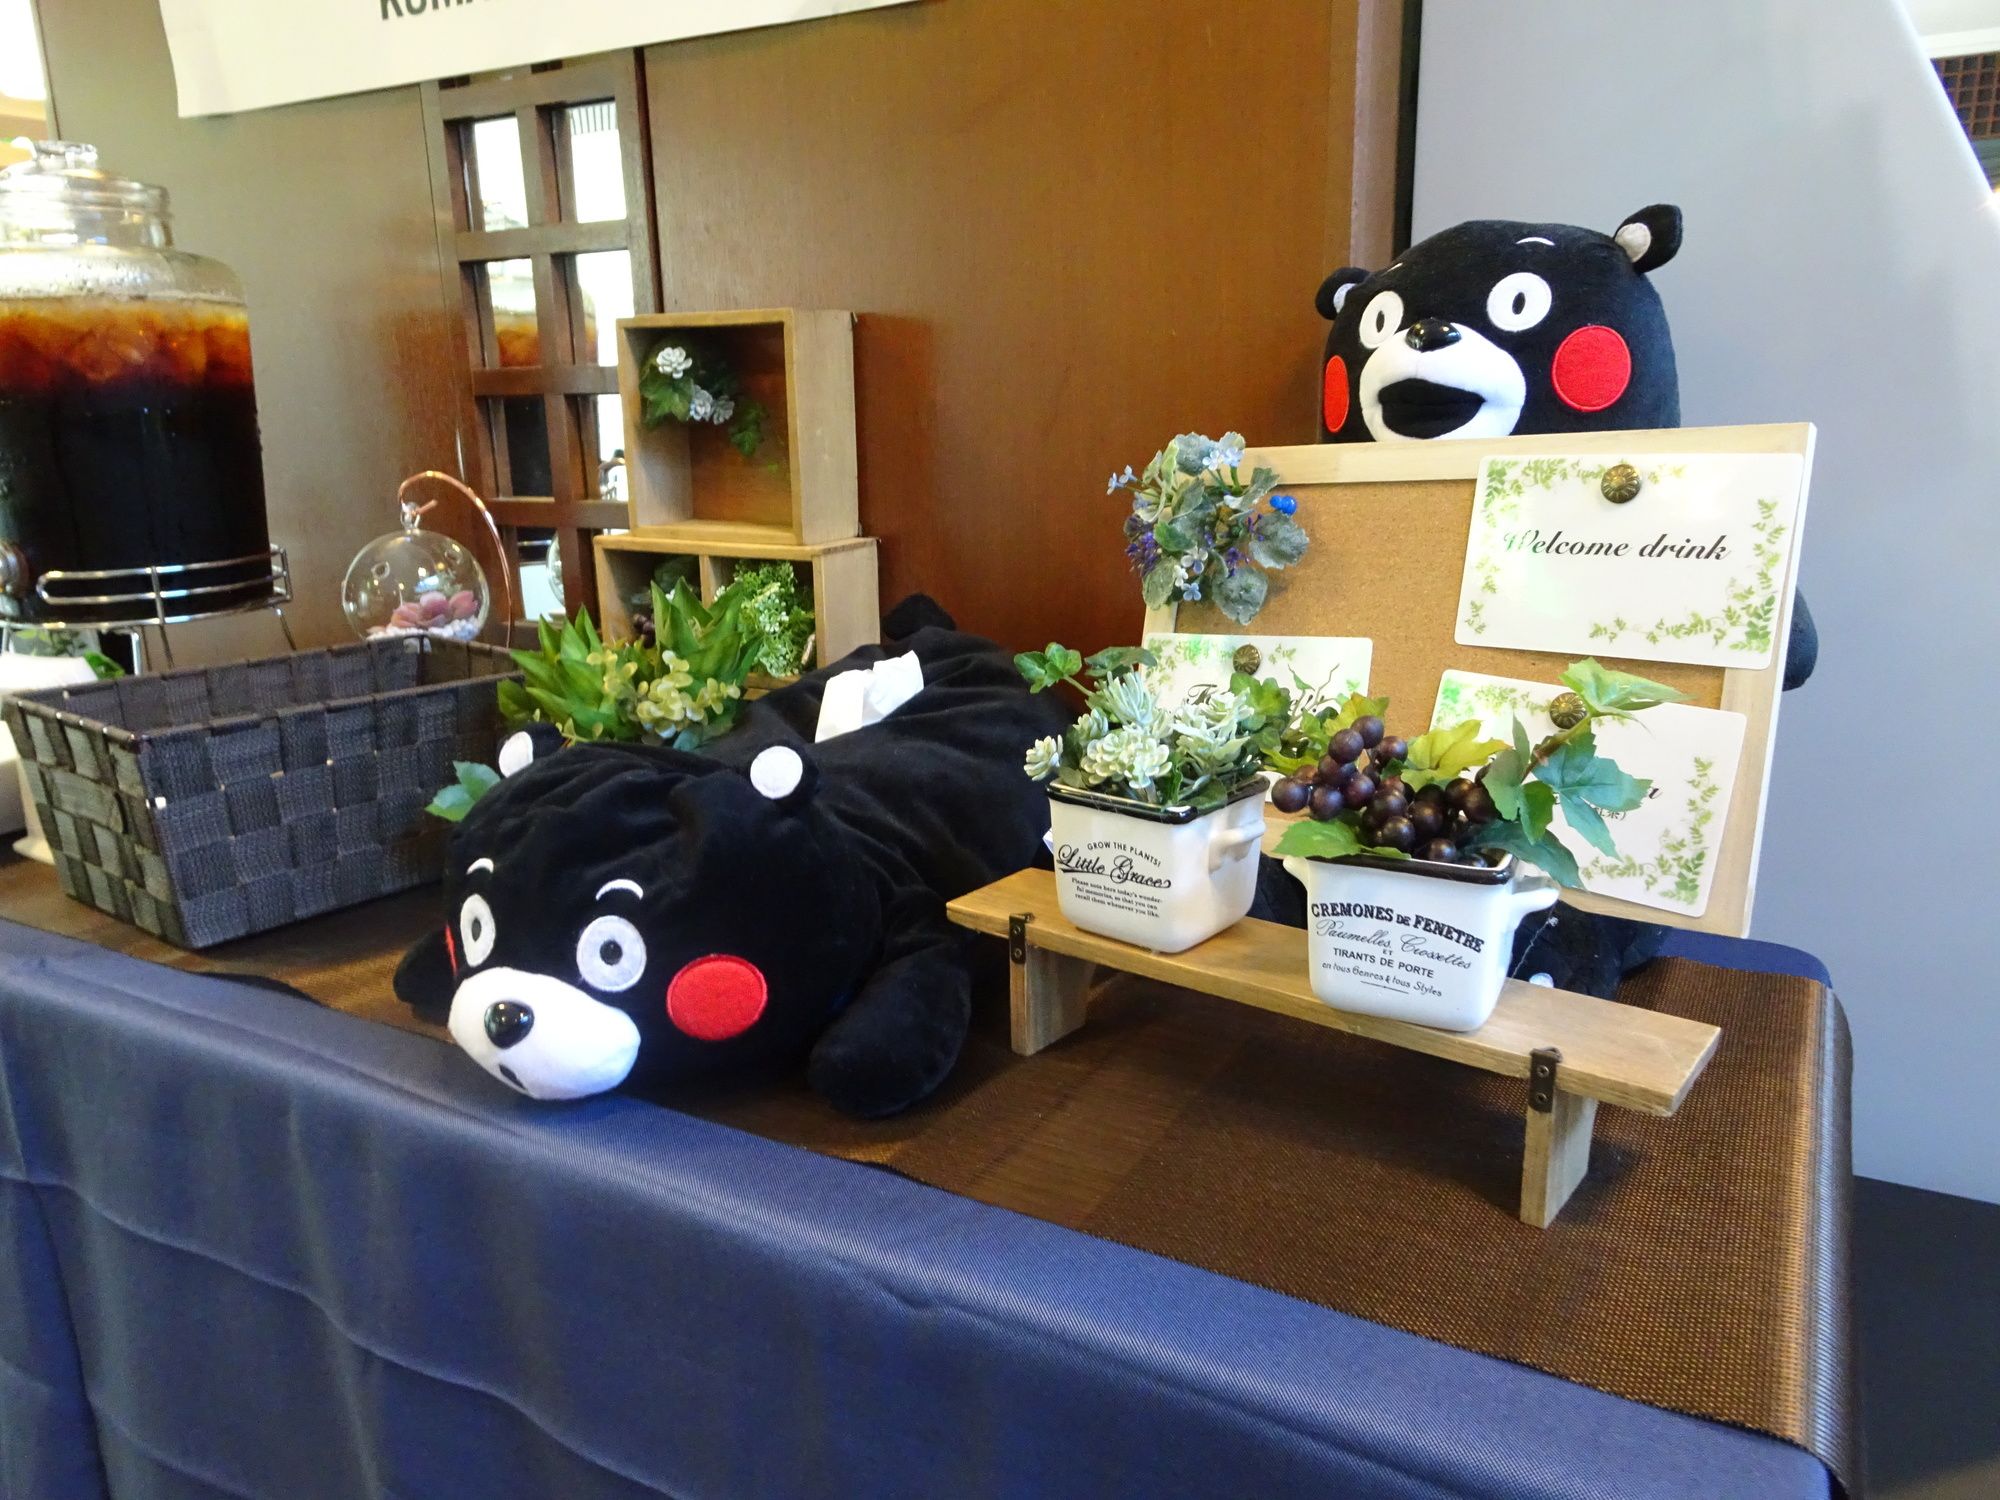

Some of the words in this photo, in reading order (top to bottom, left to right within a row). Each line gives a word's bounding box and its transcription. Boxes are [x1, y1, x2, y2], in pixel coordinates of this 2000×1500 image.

[1503, 529, 1631, 557] Welcome
[1638, 533, 1730, 560] drink
[1056, 844, 1106, 874] Little
[1110, 855, 1172, 889] Grace
[1087, 841, 1111, 850] GROW
[1113, 841, 1127, 852] THE
[1129, 846, 1161, 867] PLANTS!
[1071, 877, 1089, 886] Please
[1103, 885, 1116, 893] here
[1107, 901, 1134, 912] whenever
[1311, 902, 1394, 923] CREMONES
[1413, 914, 1485, 953] FENETRE
[1333, 947, 1376, 964] TIRANTS
[1379, 957, 1394, 968] DE
[1398, 961, 1434, 979] PORTE
[1385, 975, 1391, 984] &
[1413, 981, 1442, 997] Styles
